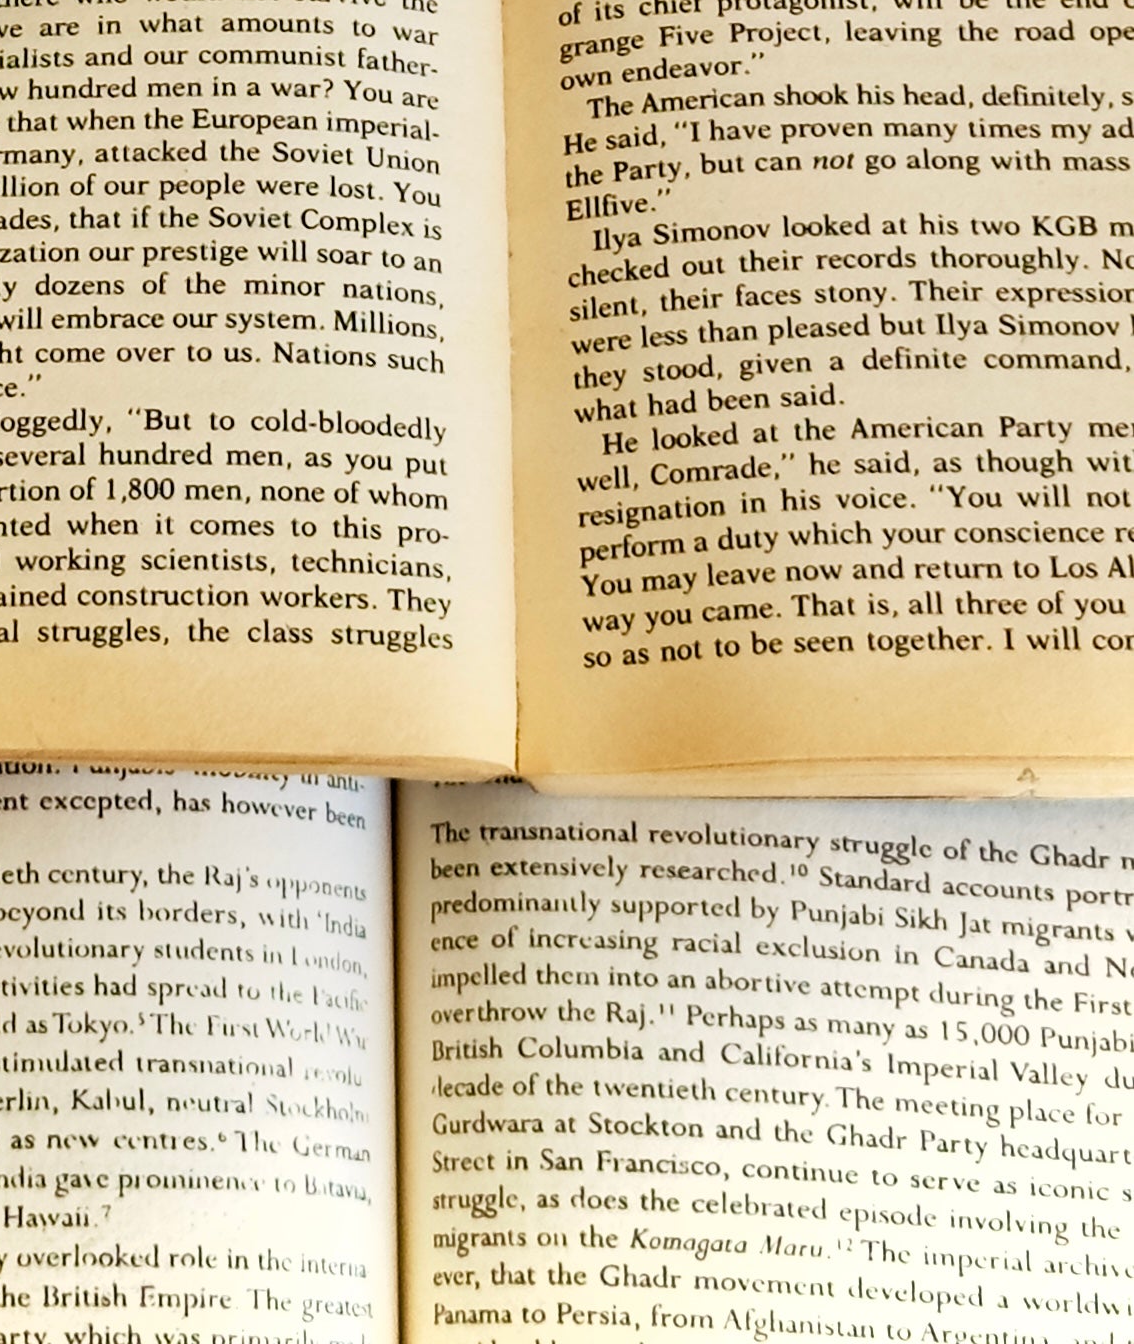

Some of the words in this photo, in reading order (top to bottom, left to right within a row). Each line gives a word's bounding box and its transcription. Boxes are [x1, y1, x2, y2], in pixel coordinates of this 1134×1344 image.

[565, 163, 604, 189] the
[612, 160, 690, 184] Party,
[699, 152, 745, 175] but
[754, 155, 803, 173] can
[812, 152, 855, 170] not
[865, 154, 897, 176] go
[906, 147, 981, 177] along
[990, 148, 1052, 172] with
[1062, 156, 1131, 172] mass
[69, 475, 97, 501] of
[107, 477, 175, 504] 1,800
[184, 484, 251, 505] men,
[260, 485, 325, 503] none
[333, 480, 361, 505] of
[368, 482, 448, 511] whom
[172, 788, 211, 813] has
[325, 800, 366, 830] been
[93, 972, 137, 997] had
[432, 1035, 504, 1062] British
[517, 1035, 645, 1061] Columbia
[658, 1039, 705, 1063] and
[720, 1042, 872, 1073] California's
[887, 1052, 999, 1086] Imperial
[1009, 1061, 1088, 1096] Valley
